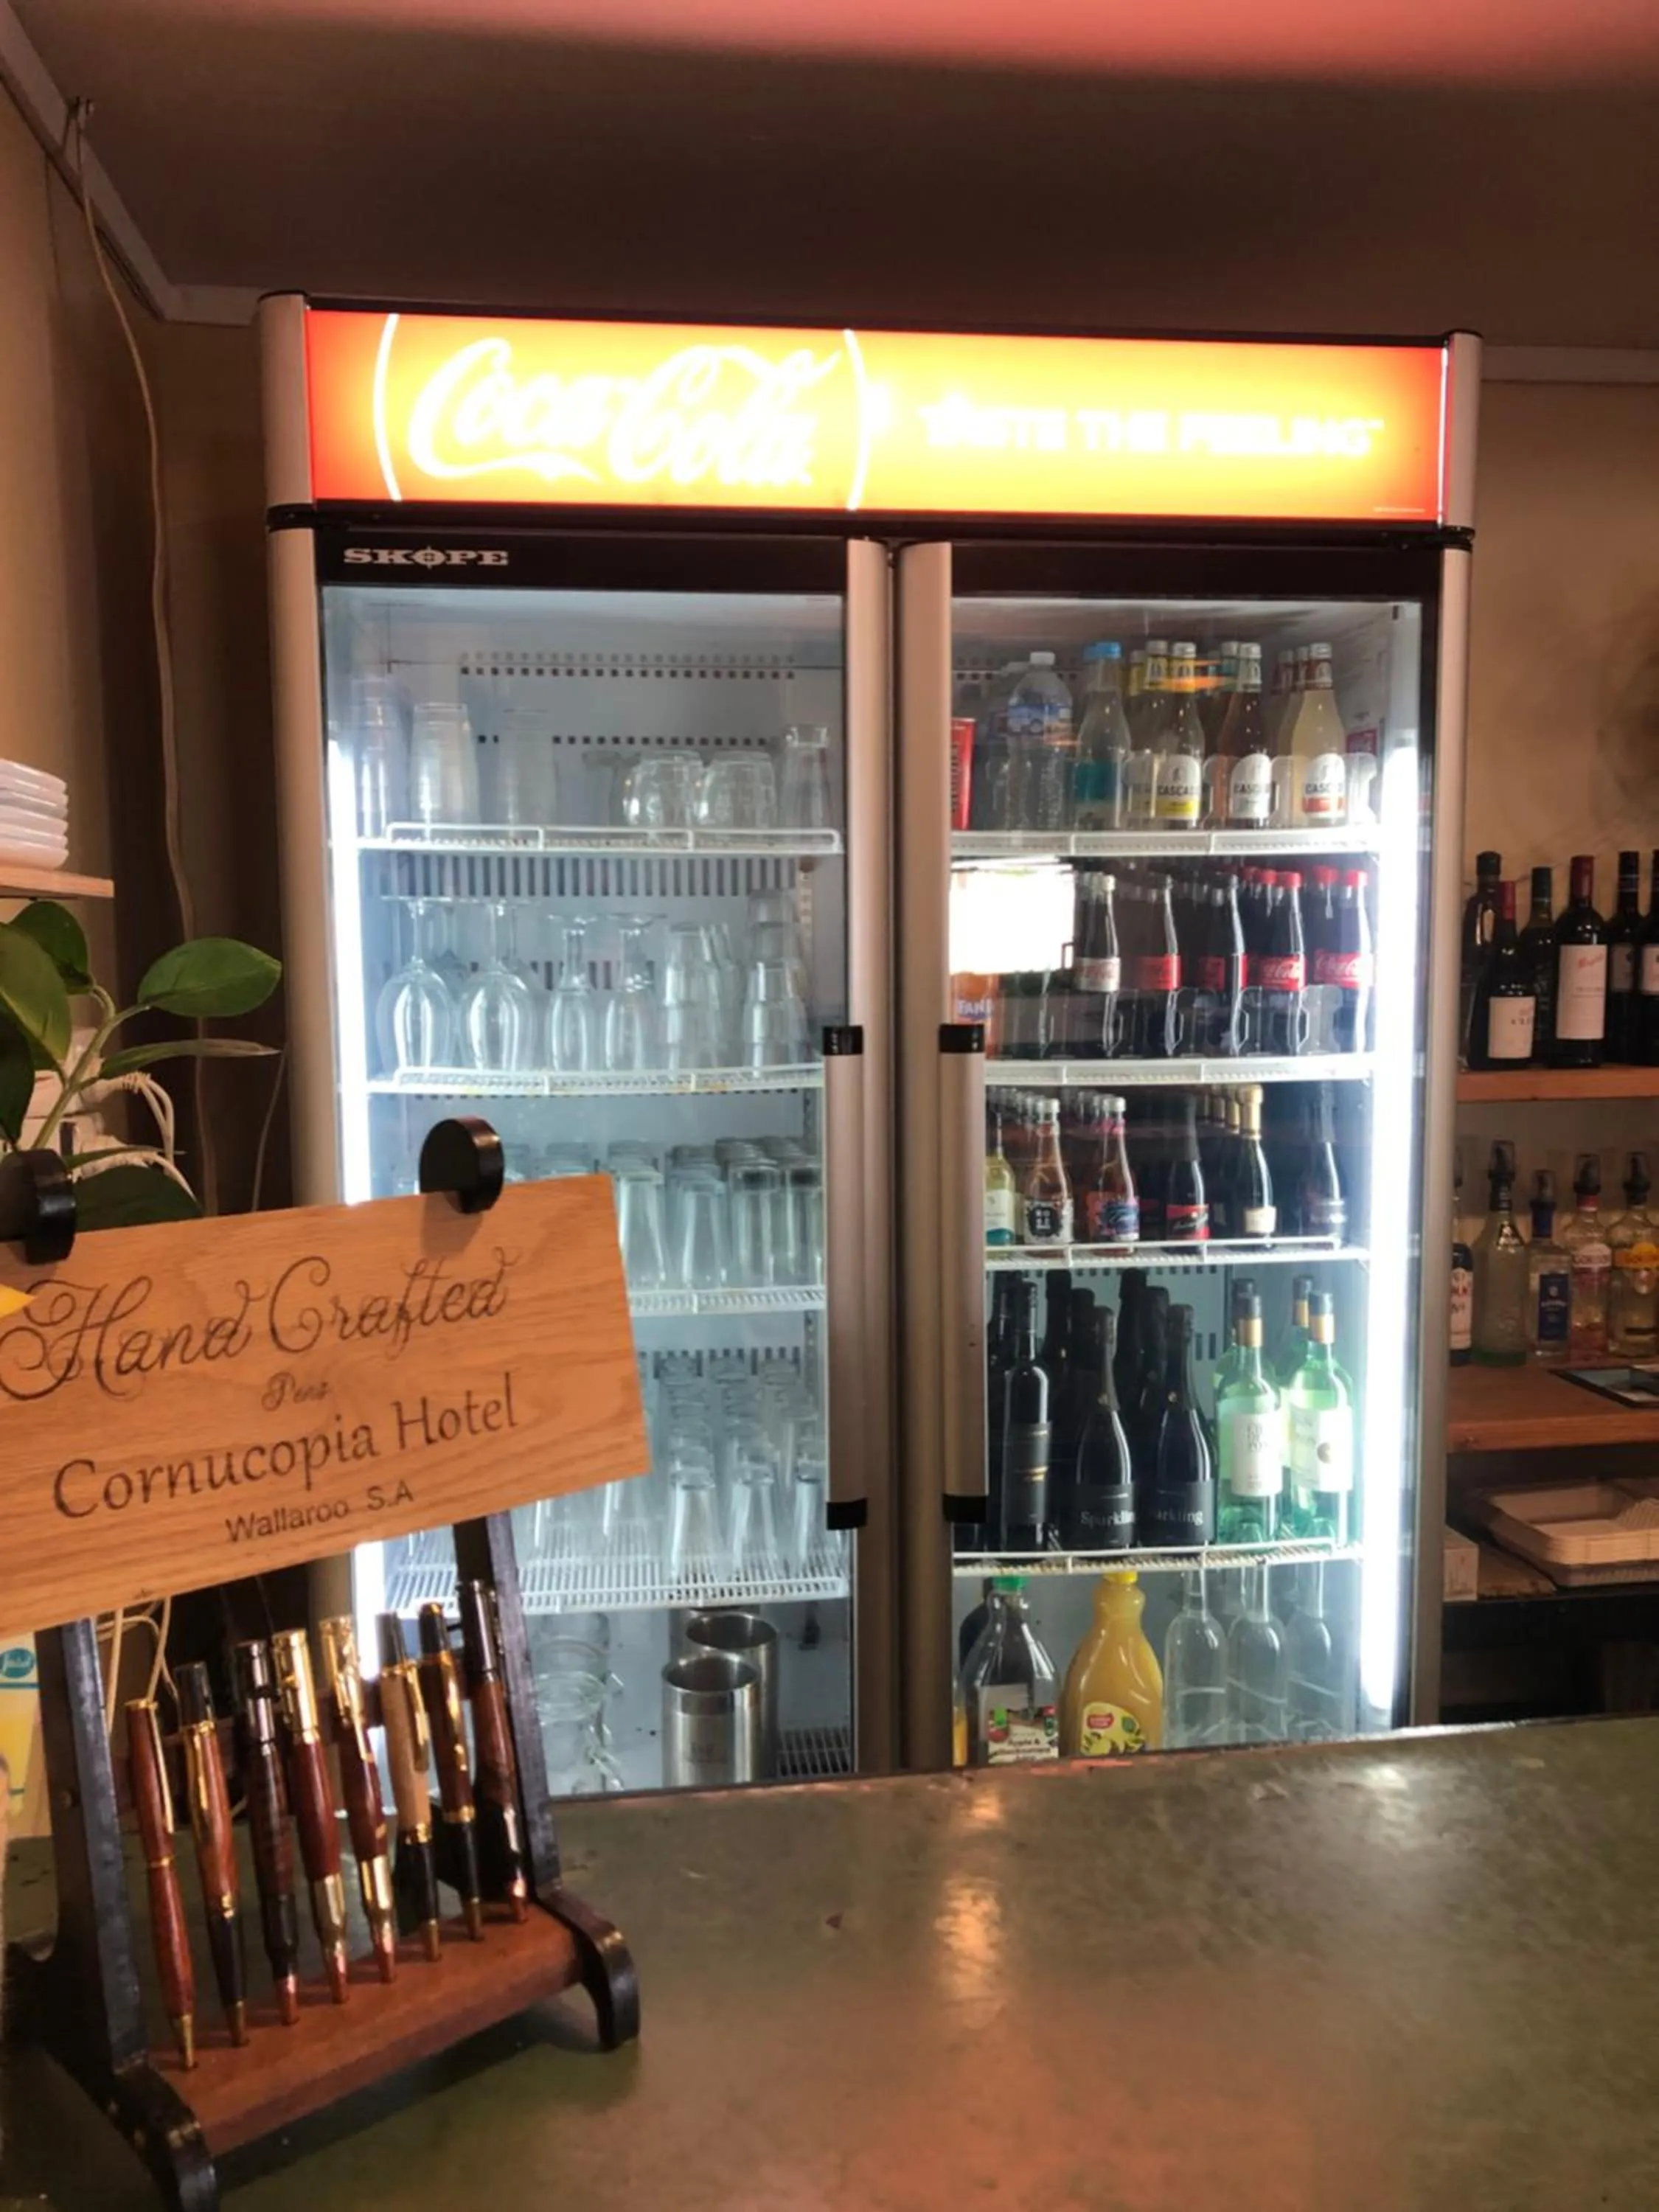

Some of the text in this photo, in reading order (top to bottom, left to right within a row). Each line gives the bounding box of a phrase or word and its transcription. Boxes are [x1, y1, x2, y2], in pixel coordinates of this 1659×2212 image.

[407, 337, 841, 485] Coca-Cola
[343, 546, 509, 569] SKOPE
[0, 1246, 519, 1401] Hand Crafted
[52, 1371, 520, 1520] Cornucopia Hotel
[225, 1499, 351, 1543] Wallaroo
